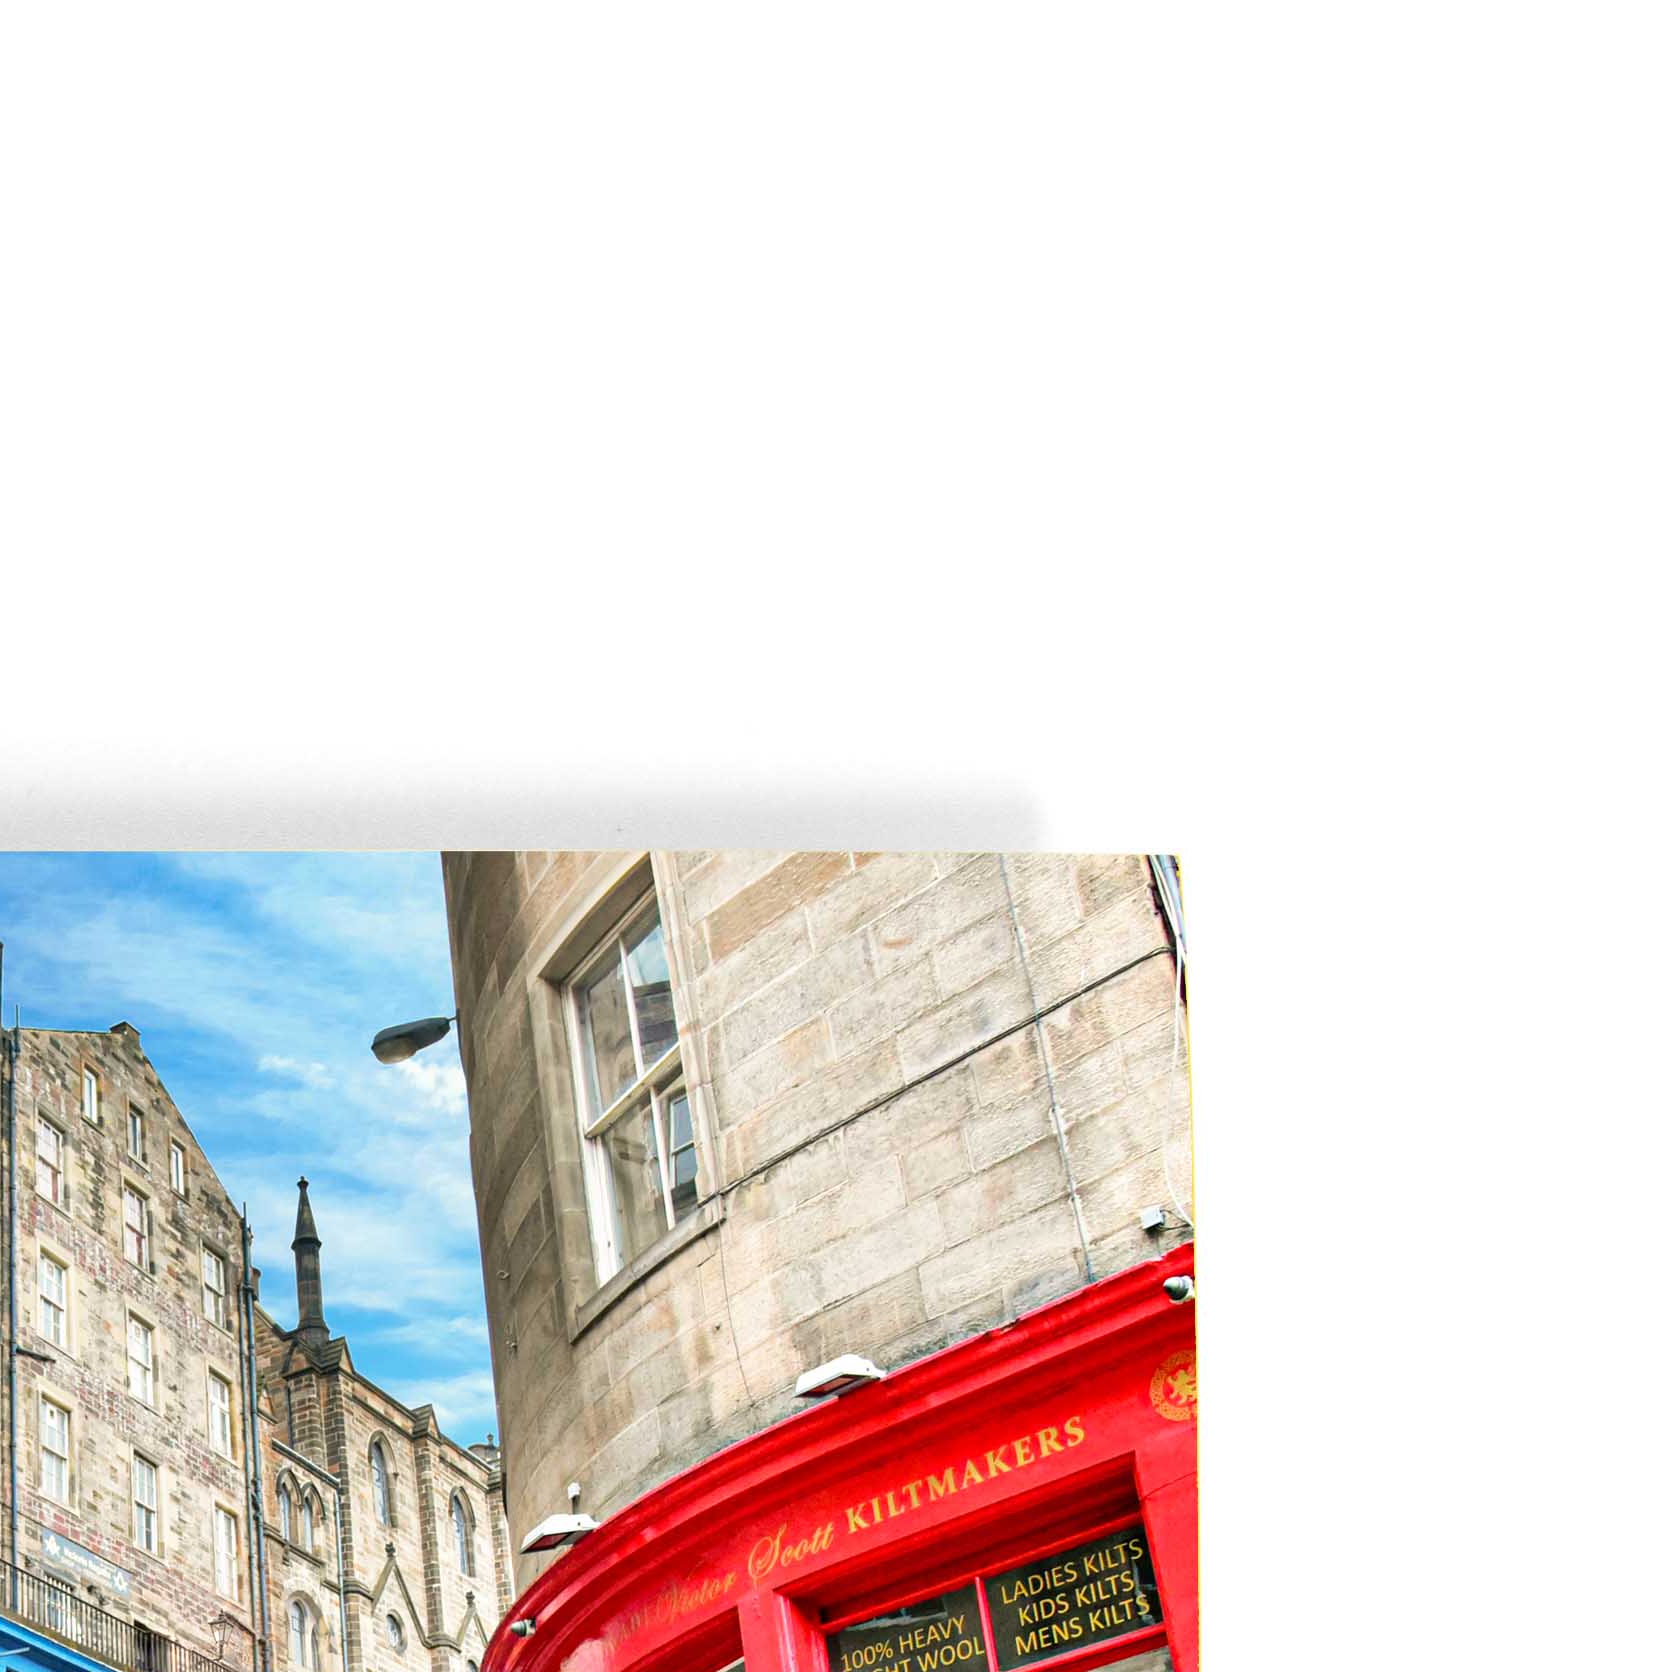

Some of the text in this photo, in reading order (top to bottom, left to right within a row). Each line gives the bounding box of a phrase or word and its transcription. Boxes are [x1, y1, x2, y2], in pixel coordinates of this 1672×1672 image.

[747, 1522, 835, 1583] Scott
[845, 1416, 1086, 1534] KILTMAKERS
[1001, 1538, 1144, 1605] LADIES KILTS
[1018, 1571, 1135, 1627] KIDS KILTS
[899, 1615, 966, 1655] HEAVY
[918, 1636, 985, 1672] WOOL
[1015, 1593, 1151, 1656] MENS KILTS
